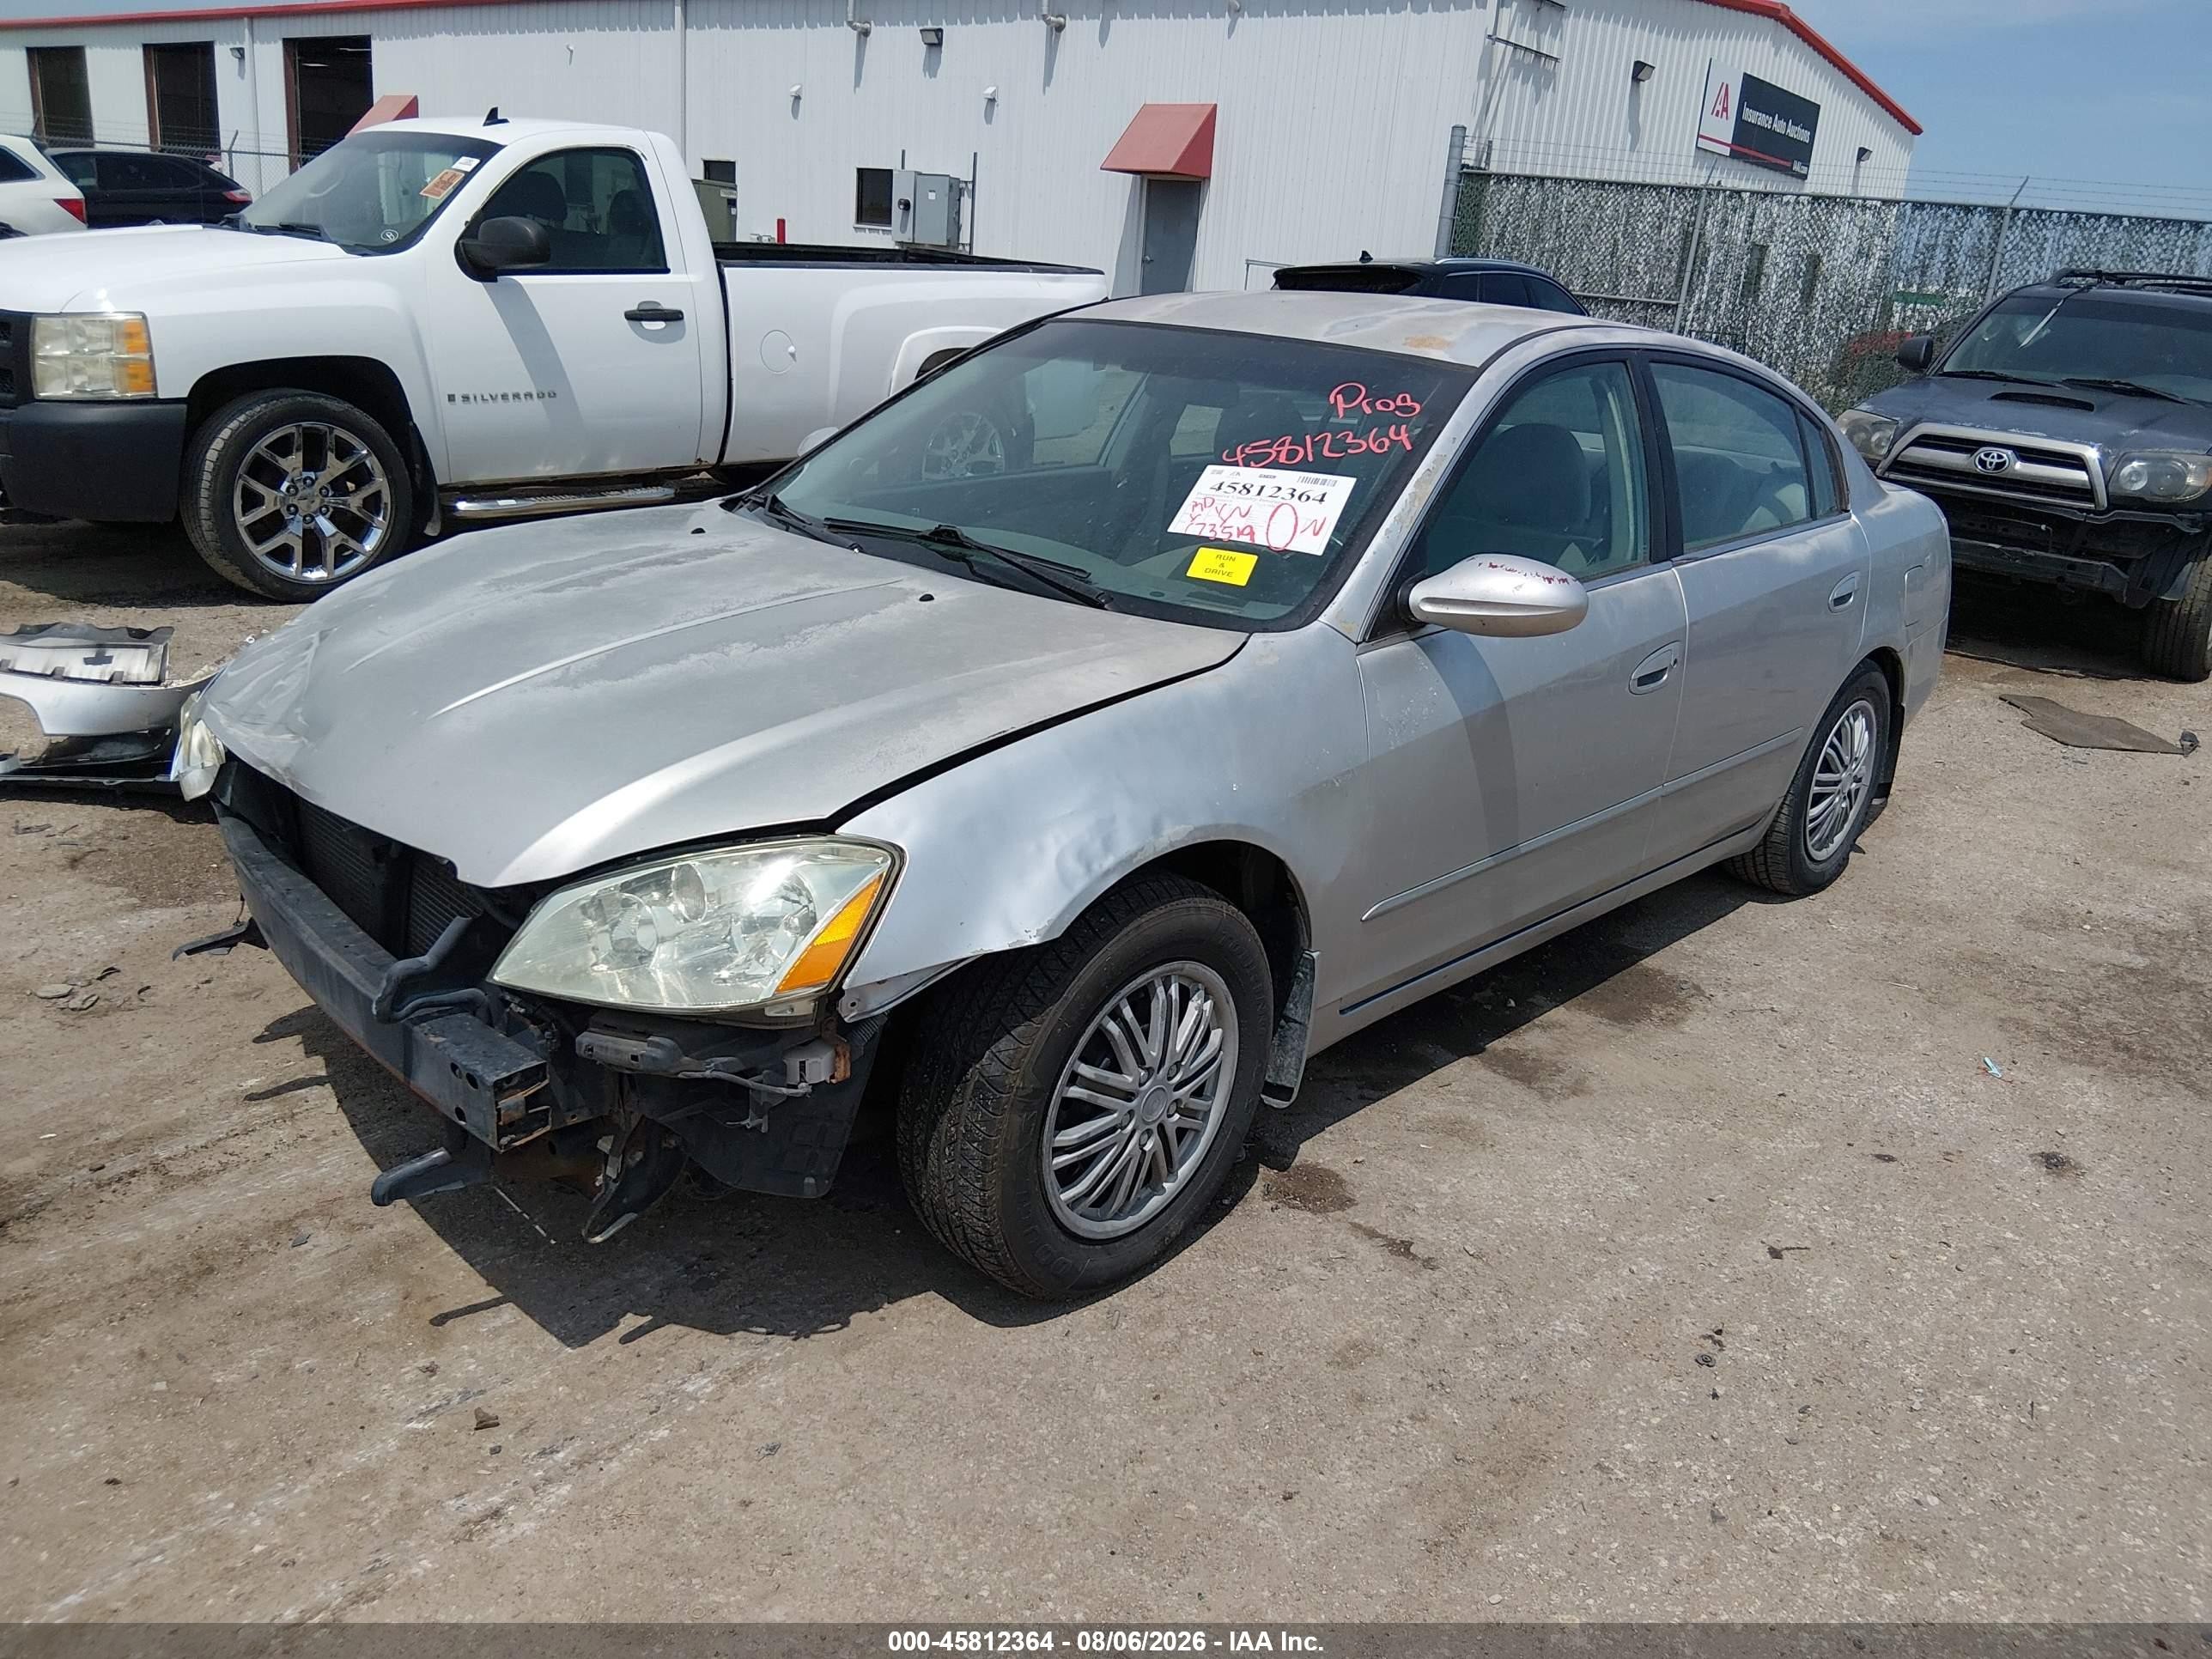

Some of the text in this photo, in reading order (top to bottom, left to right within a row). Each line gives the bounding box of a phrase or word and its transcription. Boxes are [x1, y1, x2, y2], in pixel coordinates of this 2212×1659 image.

[1741, 101, 1811, 144] Insurance Auto Auctions
[460, 391, 557, 405] SILVERADO
[1222, 423, 1413, 468] 45812364
[1209, 481, 1328, 505] 45812364
[1216, 554, 1237, 562] RUN
[1204, 568, 1234, 578] DRIVE
